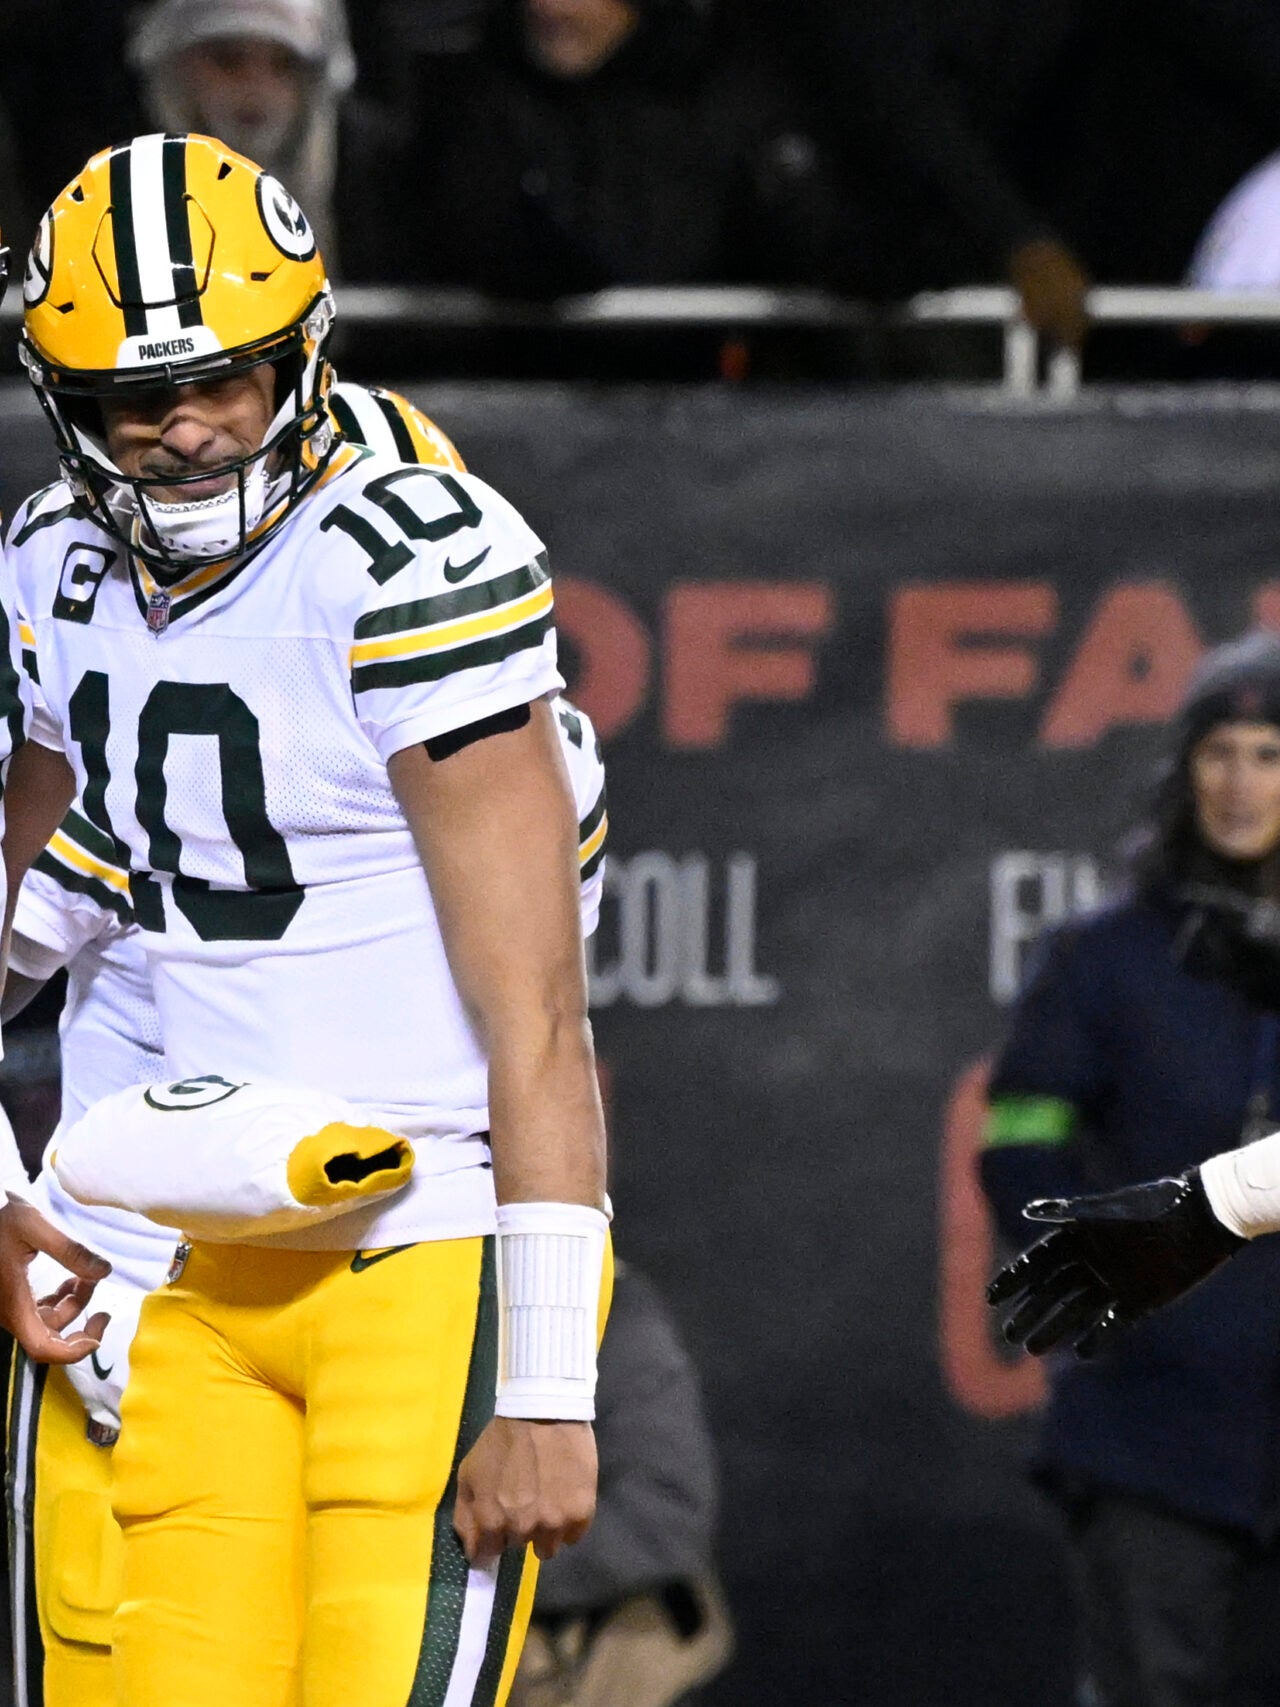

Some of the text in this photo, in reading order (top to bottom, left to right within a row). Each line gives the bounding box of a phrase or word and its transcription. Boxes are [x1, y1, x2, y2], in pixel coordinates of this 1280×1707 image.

[138, 337, 195, 360] PACKERS
[319, 467, 483, 587] 10
[69, 669, 305, 942] 10
